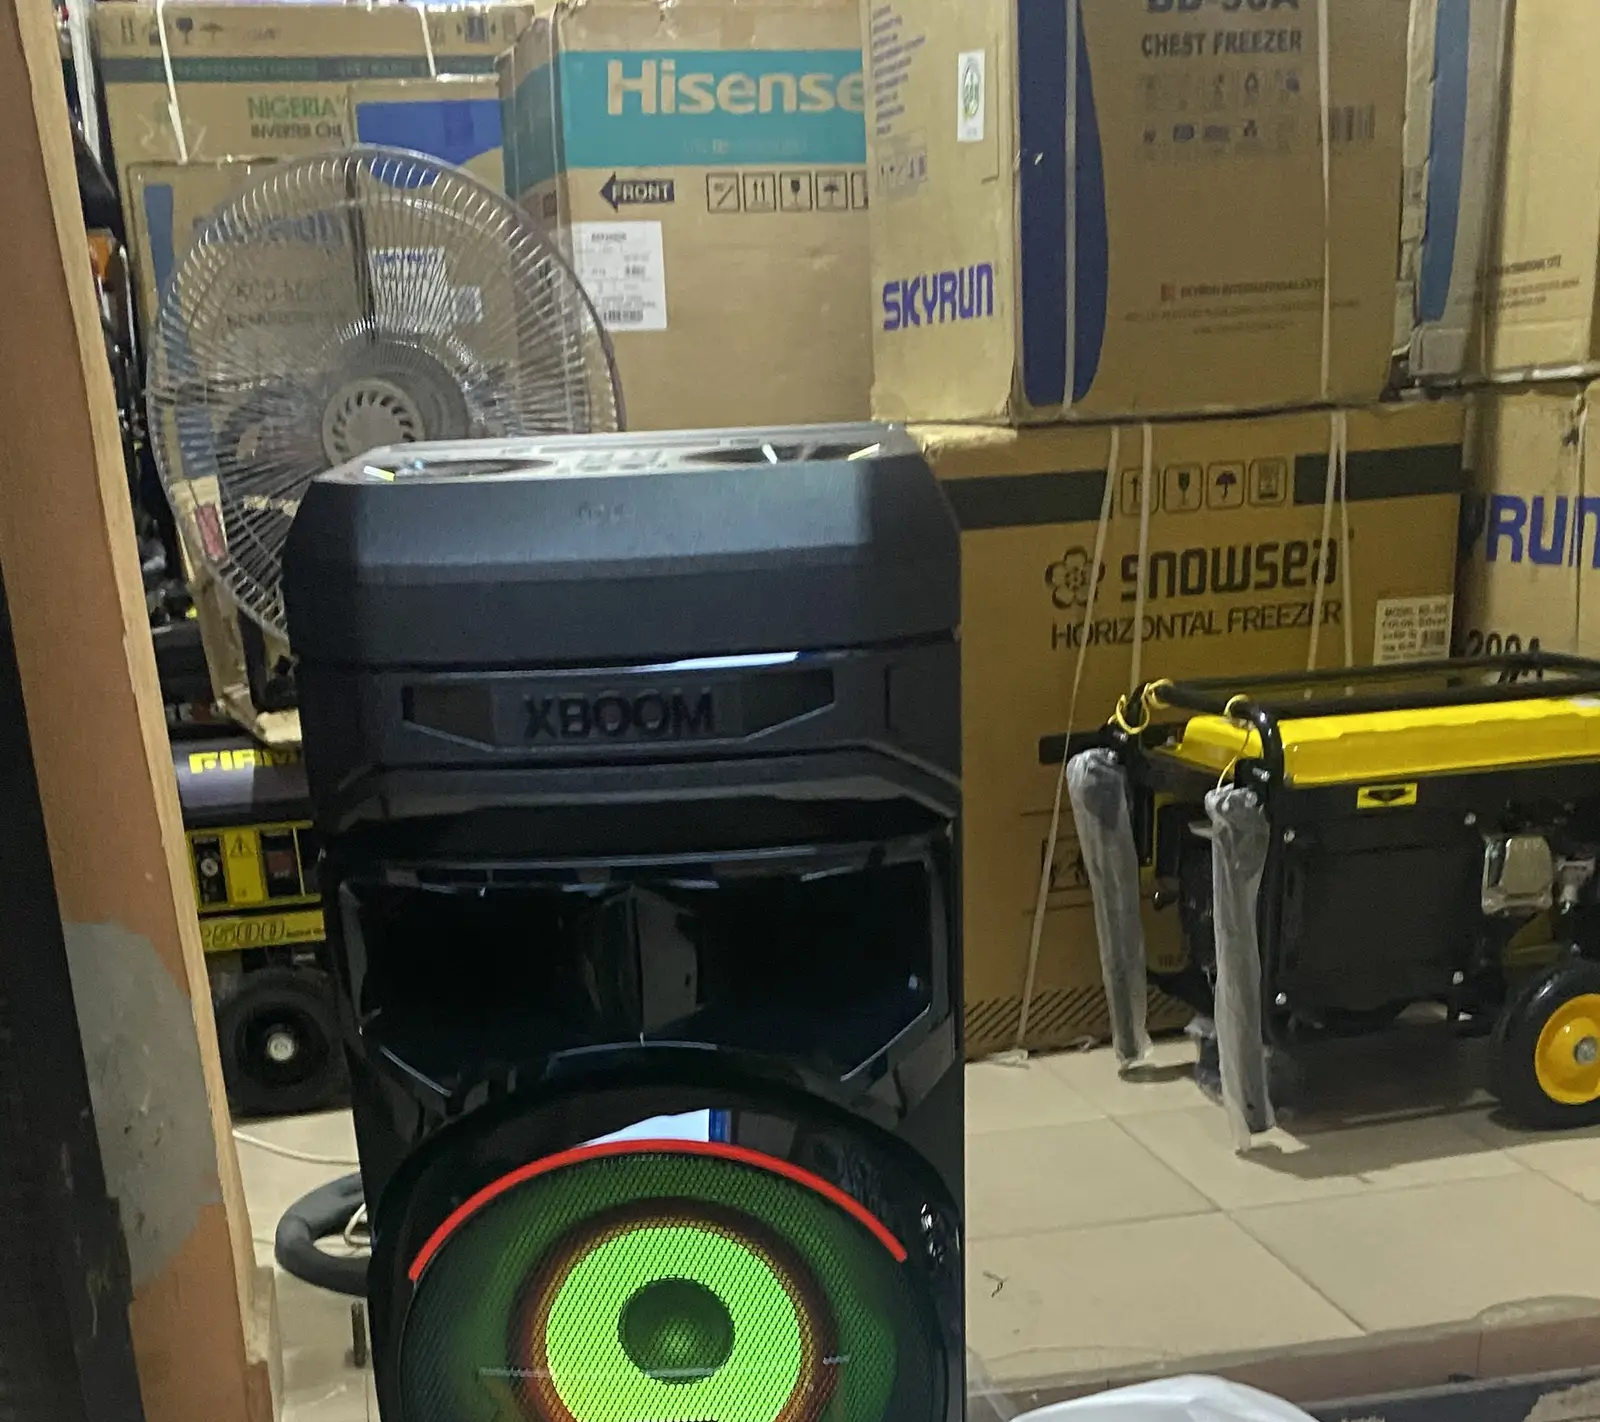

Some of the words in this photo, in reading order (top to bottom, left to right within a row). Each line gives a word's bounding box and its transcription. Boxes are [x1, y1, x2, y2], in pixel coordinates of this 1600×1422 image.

[1141, 32, 1206, 57] CHEST
[607, 58, 864, 116] Hisense
[611, 182, 669, 202] FRONT
[882, 262, 993, 331] SKYRUN
[1051, 609, 1223, 651] HORIZONTAL
[523, 688, 715, 740] XBOOM
